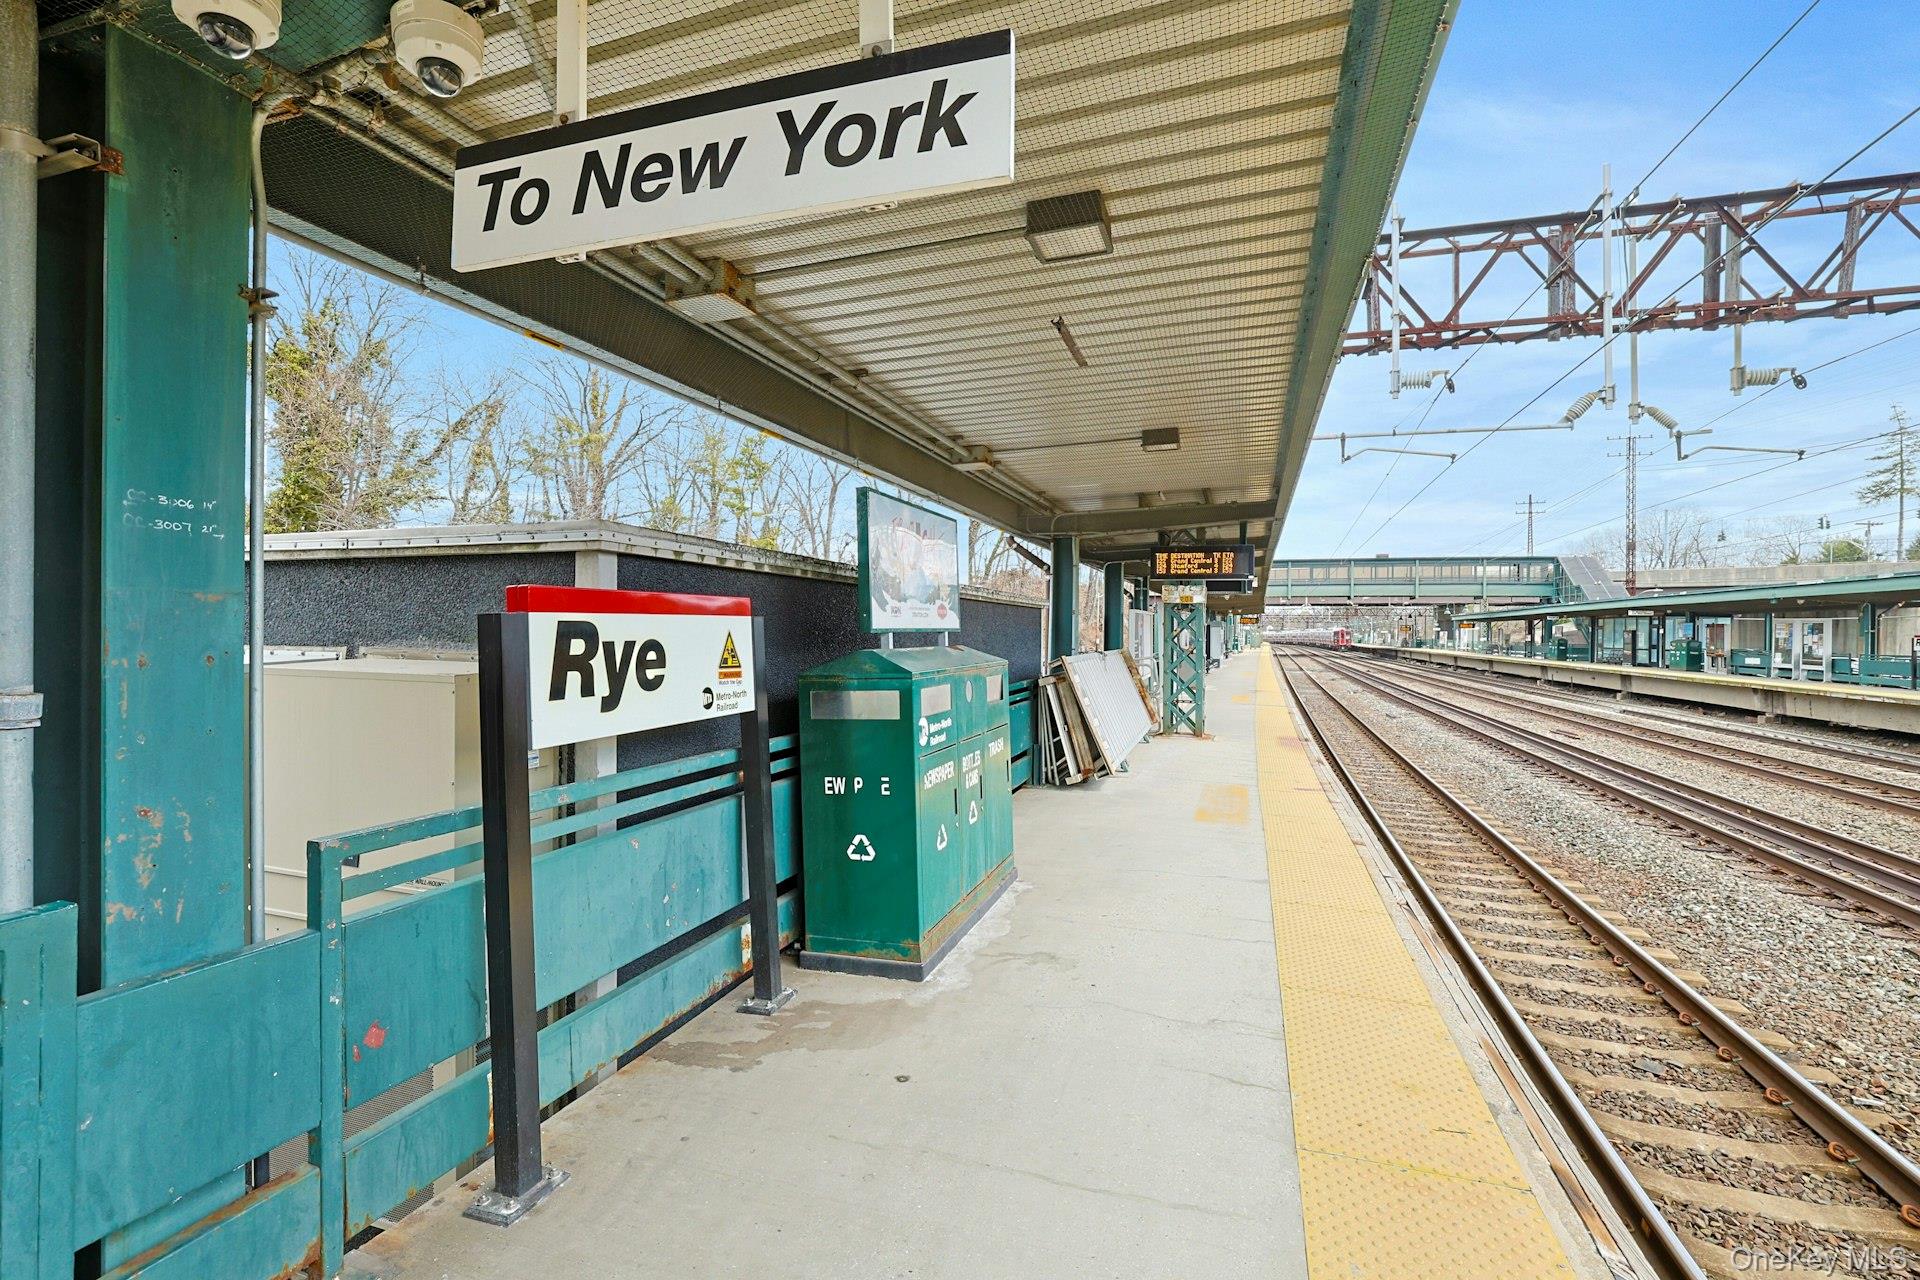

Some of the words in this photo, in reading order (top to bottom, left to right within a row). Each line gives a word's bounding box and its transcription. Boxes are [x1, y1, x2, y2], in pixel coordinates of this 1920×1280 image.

[476, 167, 550, 232] To
[571, 135, 748, 215] New
[776, 79, 979, 177] York
[548, 620, 667, 713] Rye
[716, 689, 747, 701] Metro-North
[716, 701, 738, 711] Railroad
[929, 717, 952, 734] Metro-North
[988, 737, 1004, 757] TRASH
